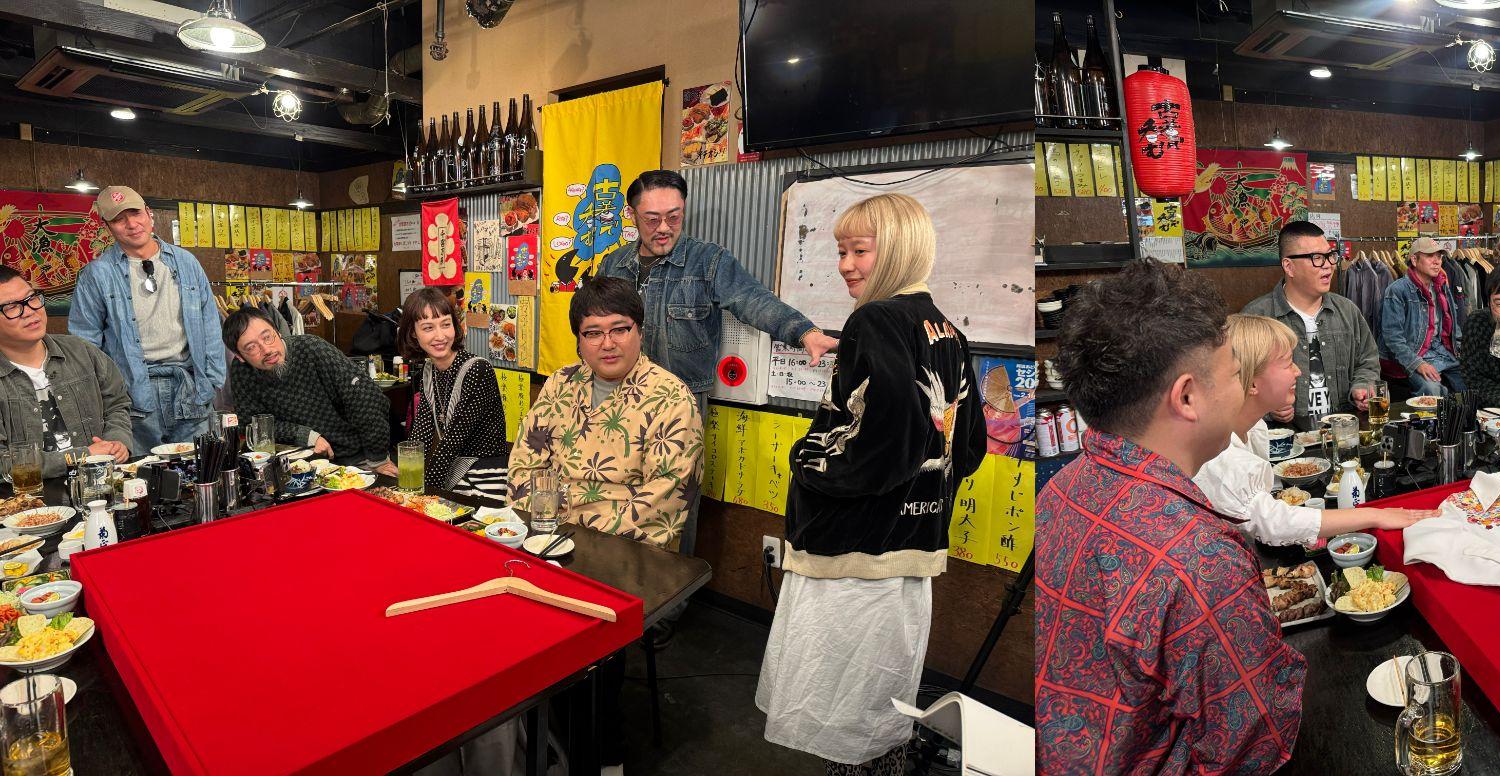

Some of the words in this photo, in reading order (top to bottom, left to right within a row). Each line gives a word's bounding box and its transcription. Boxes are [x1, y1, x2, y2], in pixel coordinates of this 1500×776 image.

[772, 356, 785, 366] 平日
[953, 546, 973, 560] 380
[994, 553, 1019, 569] 550
